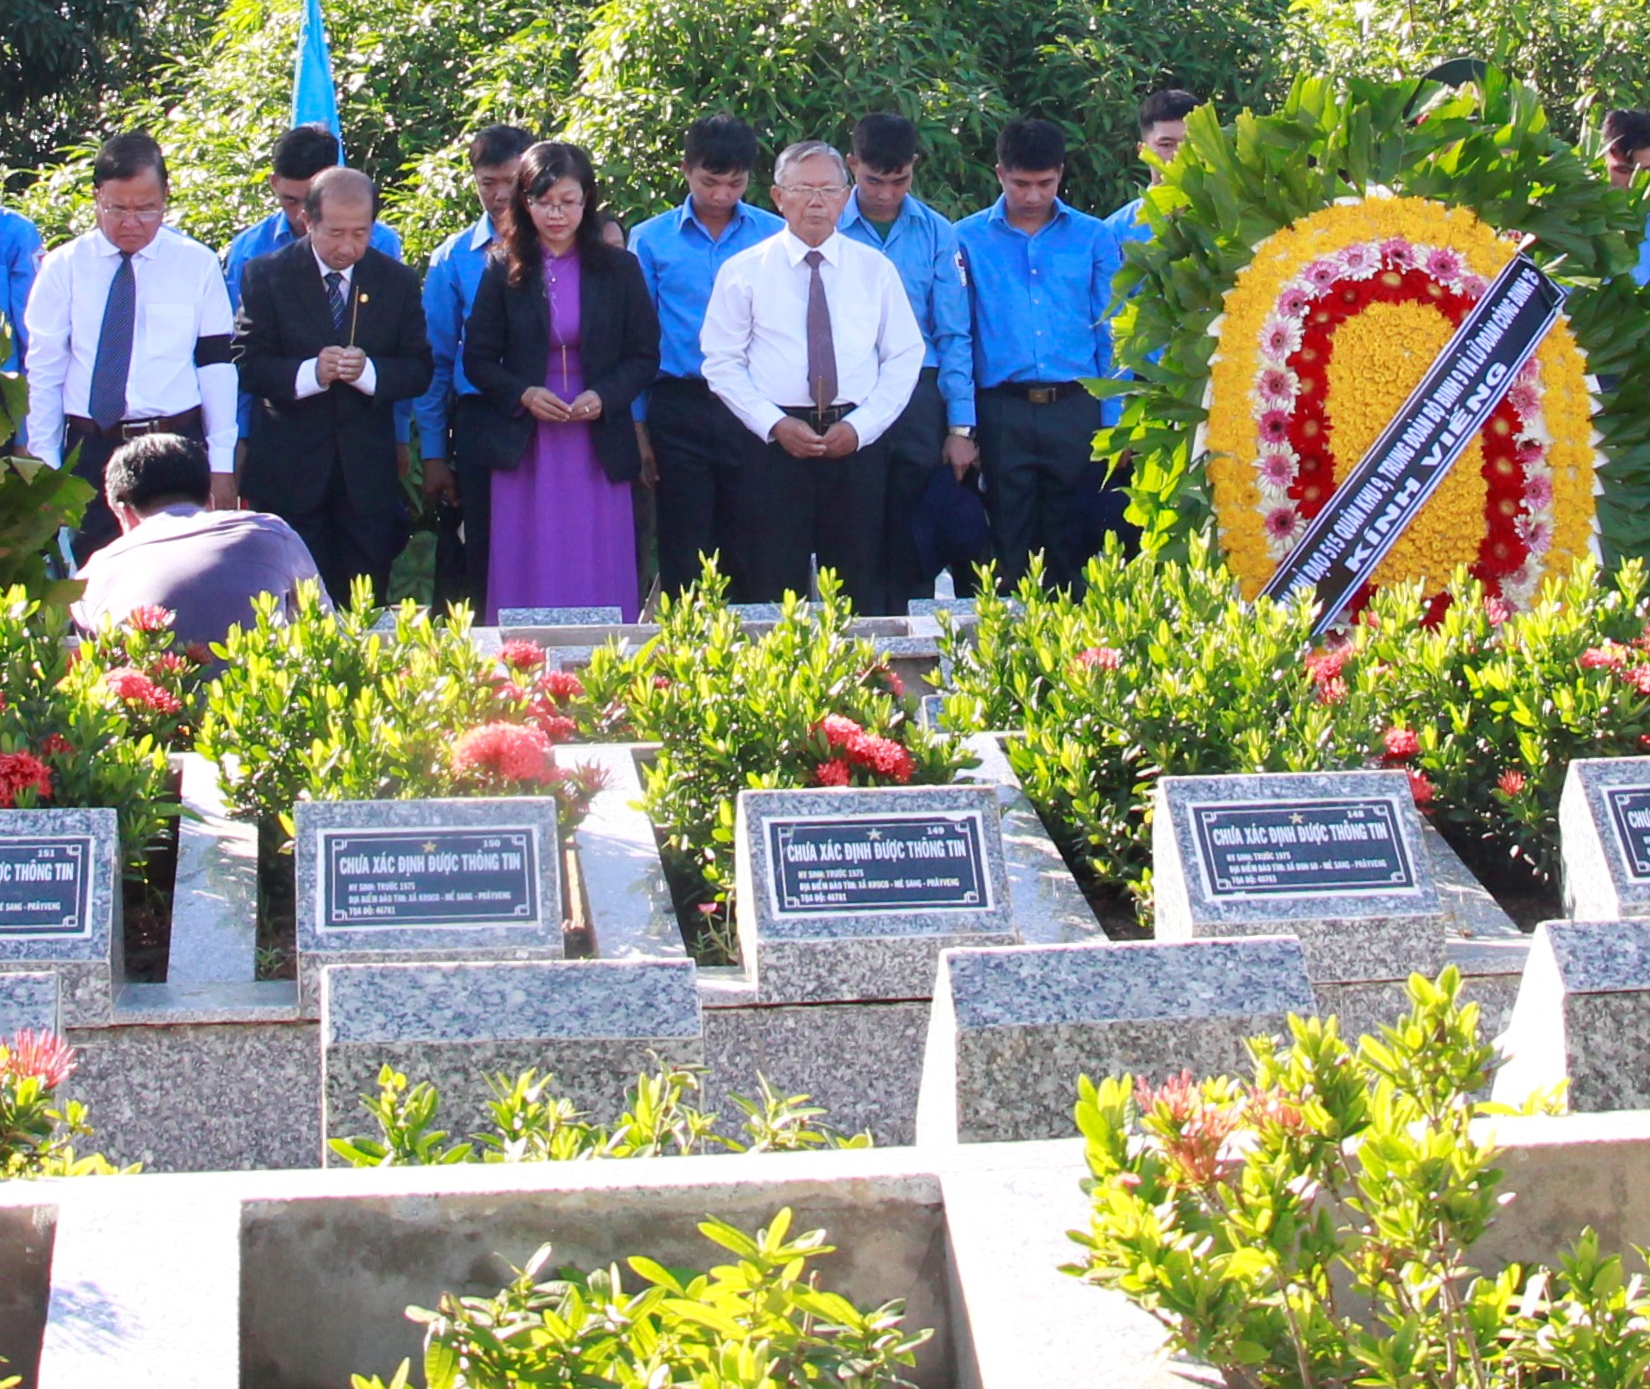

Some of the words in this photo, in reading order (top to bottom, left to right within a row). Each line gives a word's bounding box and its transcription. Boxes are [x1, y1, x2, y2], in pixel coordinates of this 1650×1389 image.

[1507, 277, 1535, 307] BINH
[1491, 298, 1520, 329] CÔNG
[1451, 369, 1469, 385] 9
[1456, 353, 1481, 377] VÀ
[1433, 376, 1464, 409] BINH
[1422, 398, 1449, 423] BỘ
[1344, 477, 1421, 572] KÍNH
[1421, 362, 1507, 466] VIẾNG
[1377, 441, 1415, 481] TRUNG
[1353, 483, 1382, 514] KHU
[1333, 504, 1367, 540] QUÂN
[1319, 533, 1346, 559] 515
[483, 839, 501, 848] 150
[927, 827, 945, 835] 149
[1212, 825, 1244, 845] CHƯA
[1244, 823, 1268, 844] XÁC
[1268, 825, 1297, 846] ĐỊNH
[1296, 822, 1329, 845] ĐƯỢC
[1328, 819, 1368, 841] THÔNG
[1367, 822, 1388, 839] TIN
[38, 849, 55, 857] 151
[340, 854, 370, 875] CHƯA
[372, 852, 395, 873] XÁC
[398, 855, 425, 876] ĐỊNH
[428, 851, 459, 875] ĐƯỢC
[461, 849, 499, 871] THÔNG
[501, 852, 521, 870] TIN
[787, 841, 817, 862] CHƯA
[819, 839, 842, 861] XÁC
[844, 842, 872, 864] ĐỊNH
[874, 839, 905, 862] ĐƯỢC
[906, 836, 945, 858] THÔNG
[946, 839, 966, 857] TIN
[14, 859, 52, 881] THÔNG
[54, 862, 74, 880] TIN
